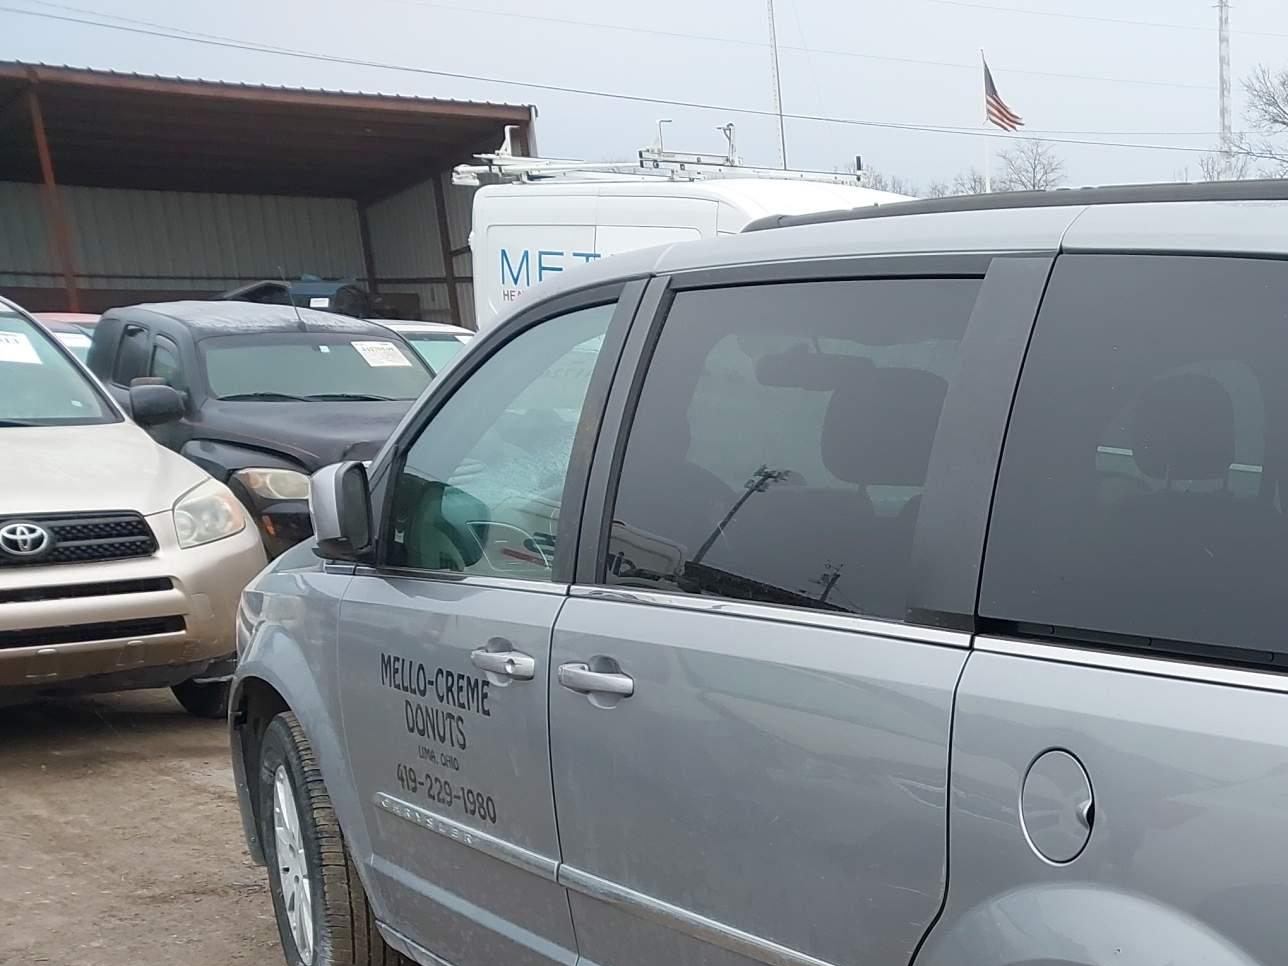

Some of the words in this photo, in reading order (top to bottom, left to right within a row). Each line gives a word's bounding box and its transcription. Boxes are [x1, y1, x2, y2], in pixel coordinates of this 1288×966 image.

[501, 249, 601, 287] MET
[381, 653, 491, 717] MELLO-CREME
[405, 699, 467, 751] DONUTS
[397, 763, 497, 824] 419-229-1980
[381, 798, 473, 845] CHRYSLER
